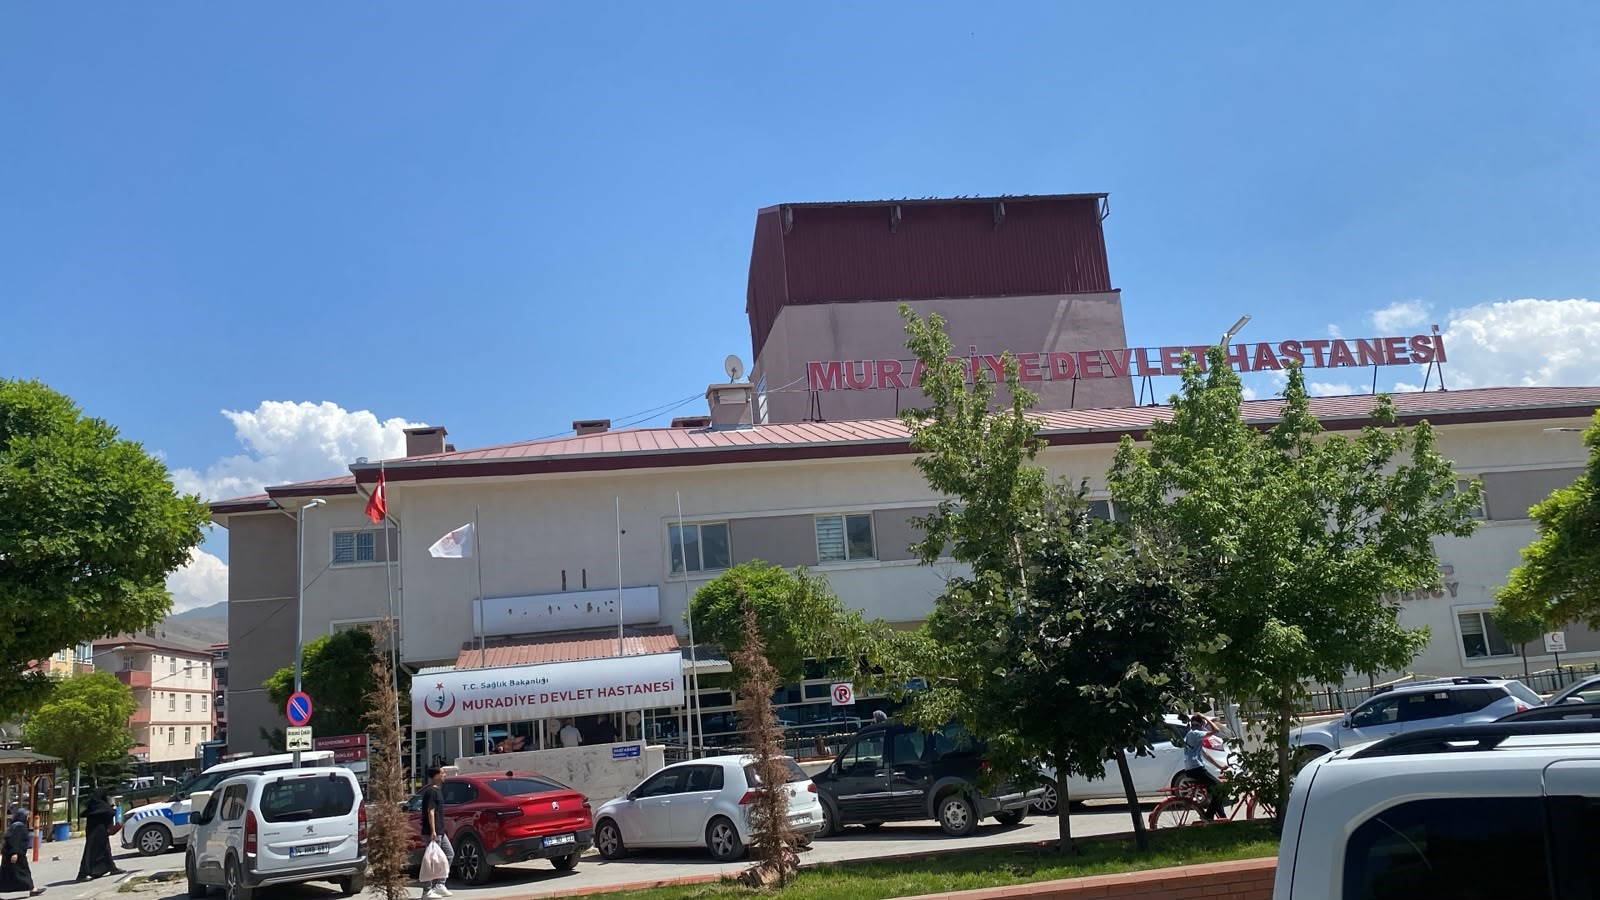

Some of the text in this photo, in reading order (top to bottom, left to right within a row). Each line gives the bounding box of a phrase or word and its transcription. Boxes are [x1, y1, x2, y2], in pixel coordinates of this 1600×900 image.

[1050, 345, 1212, 381] DEVLET
[1225, 324, 1448, 373] HASTANESİ
[462, 678, 674, 711] MURADİYE DEVLET HASTANESİ
